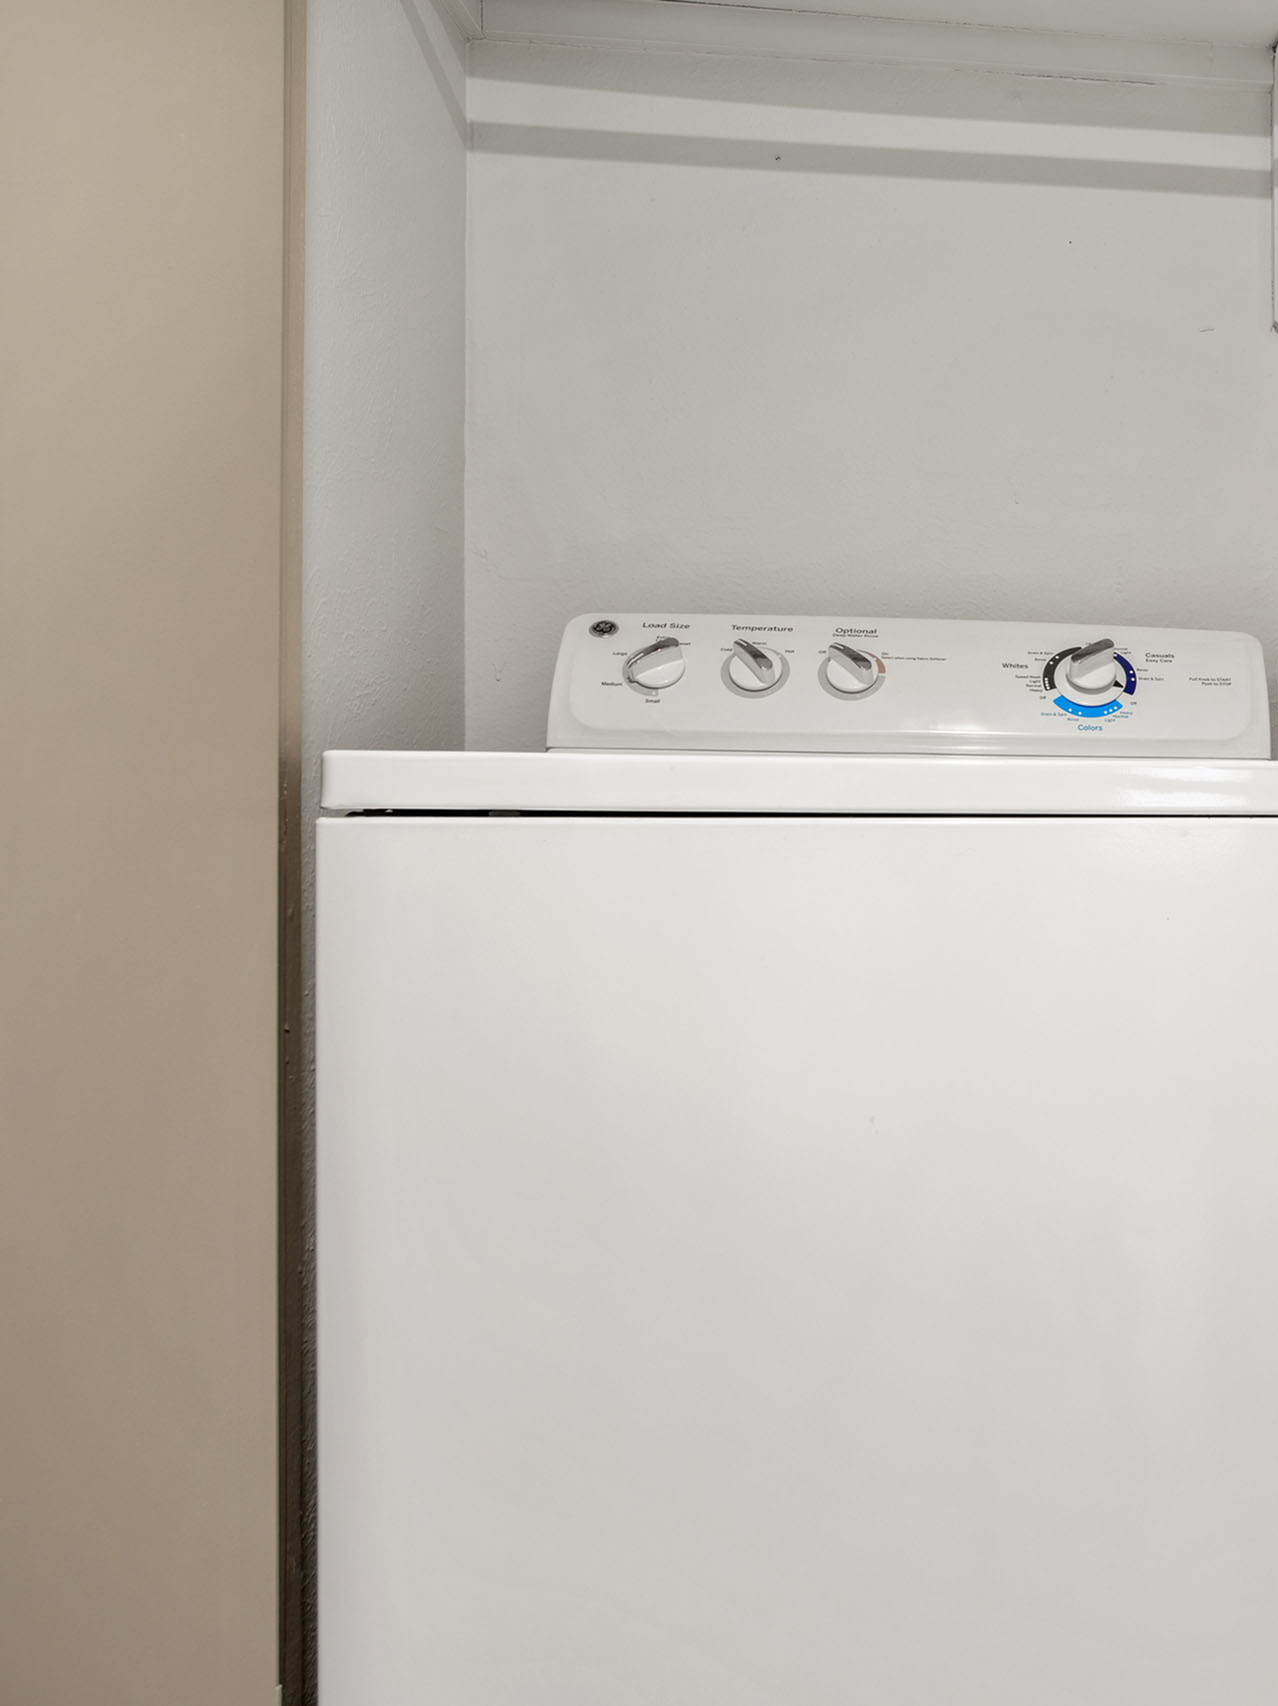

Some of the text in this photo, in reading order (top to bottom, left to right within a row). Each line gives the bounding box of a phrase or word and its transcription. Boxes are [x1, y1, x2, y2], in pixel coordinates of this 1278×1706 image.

[669, 622, 690, 630] Size
[730, 624, 794, 632] Temperature
[835, 627, 878, 635] Optional
[1002, 662, 1029, 670] Whites
[1077, 724, 1103, 732] Colors
